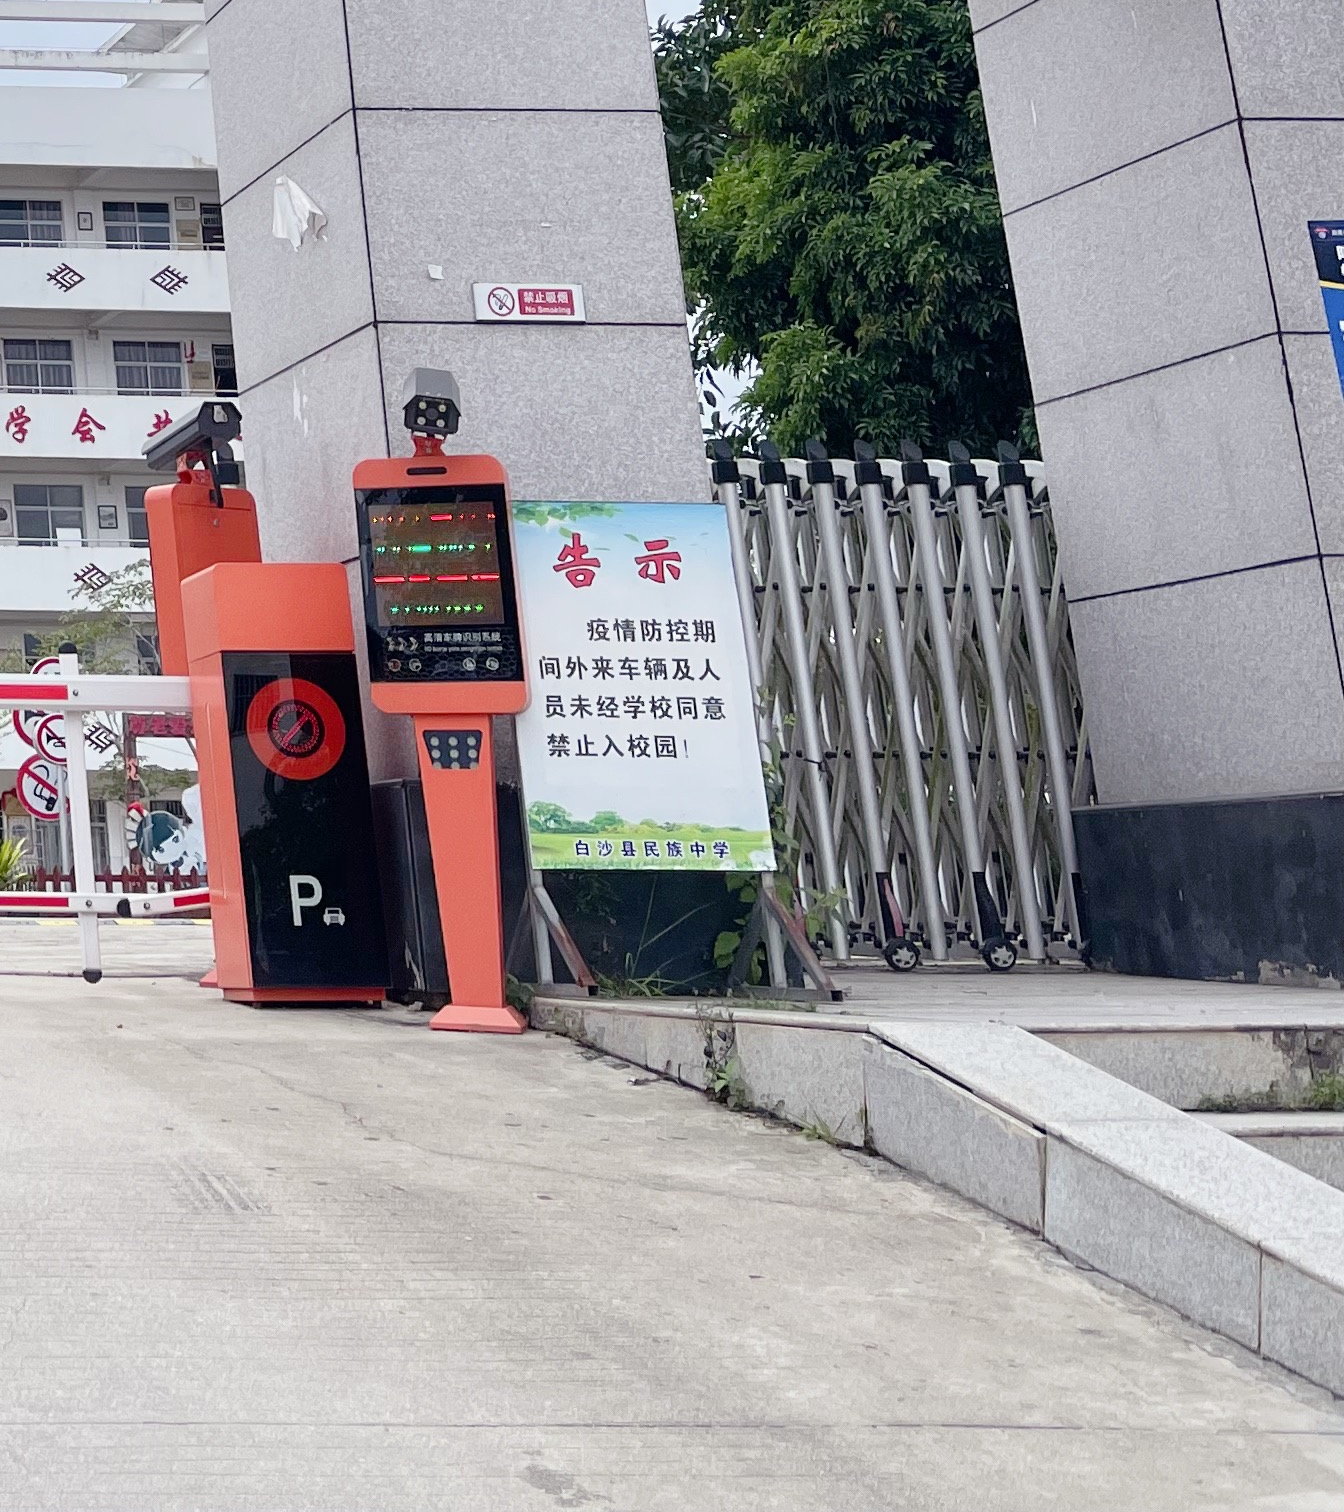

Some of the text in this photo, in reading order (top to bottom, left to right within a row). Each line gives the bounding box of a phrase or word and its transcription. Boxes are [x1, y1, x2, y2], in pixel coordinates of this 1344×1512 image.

[523, 291, 569, 304] 禁止吸烟
[552, 532, 682, 588] 告示
[586, 619, 716, 644] 疫情防控期
[539, 655, 721, 683] 间外来车辆及人
[544, 694, 727, 721] 员未经学校同意
[547, 733, 690, 759] 禁止入校园！
[574, 840, 731, 859] 白沙县民族中学
[289, 874, 323, 927] P
